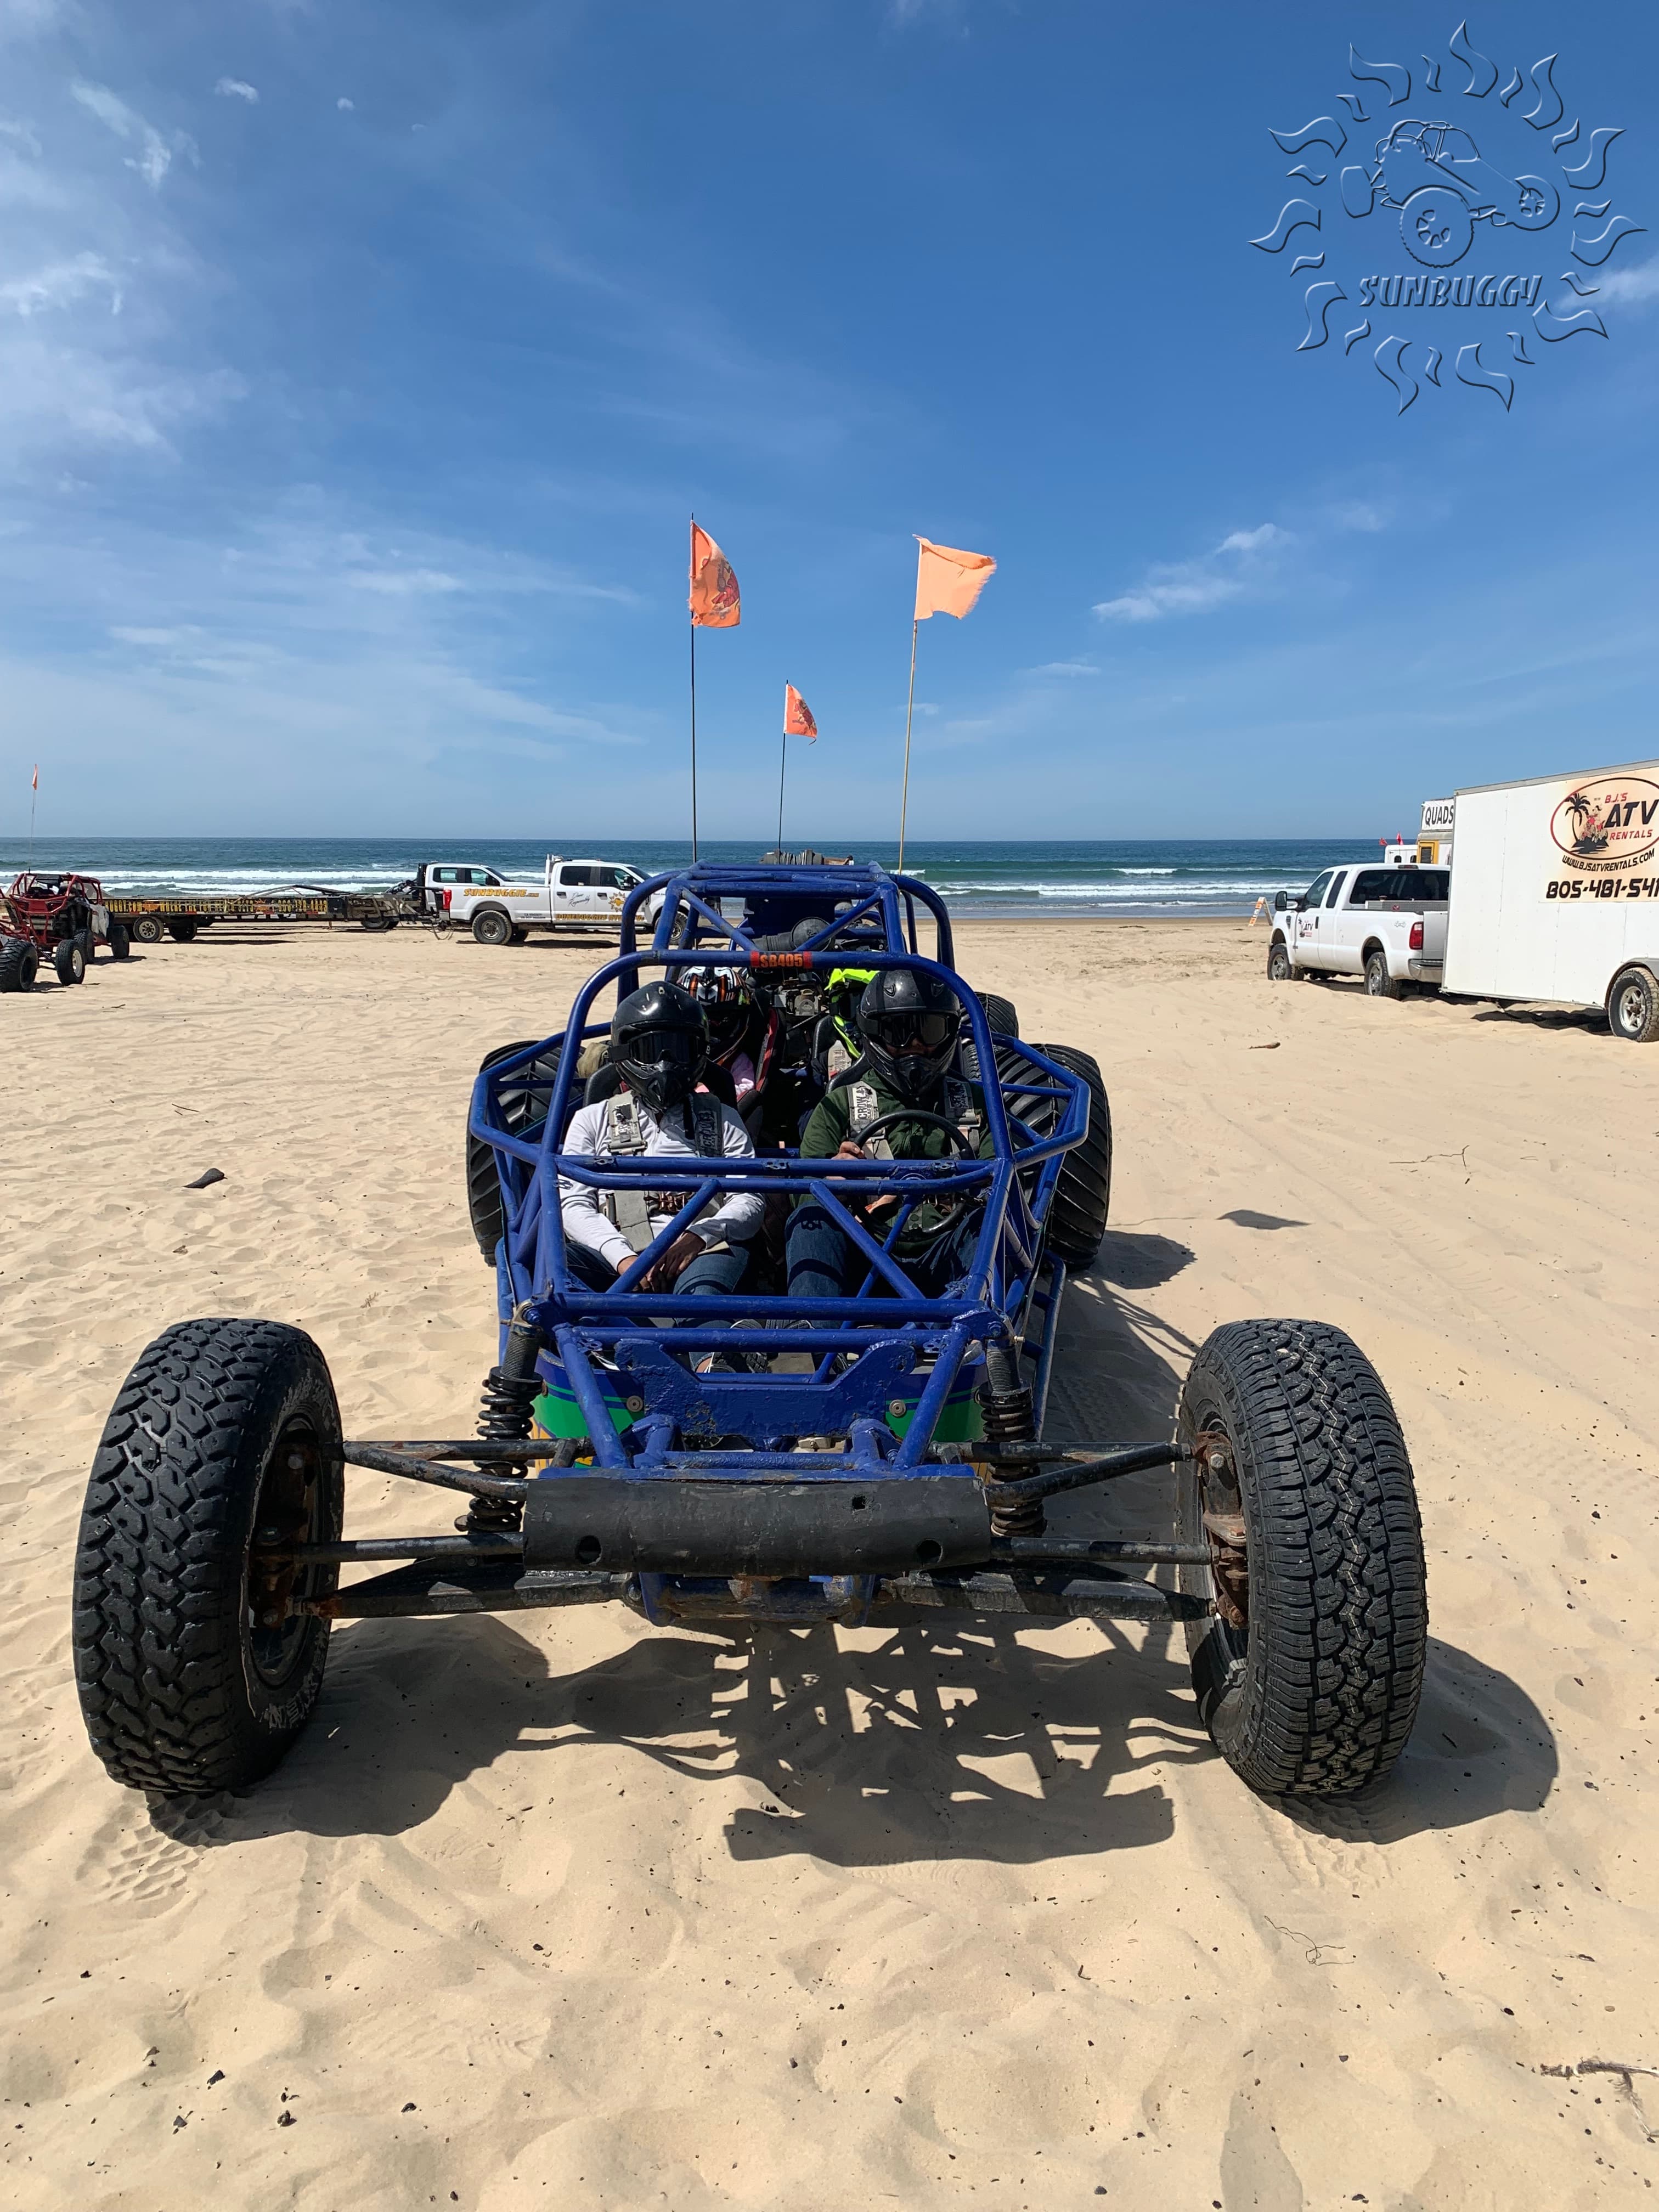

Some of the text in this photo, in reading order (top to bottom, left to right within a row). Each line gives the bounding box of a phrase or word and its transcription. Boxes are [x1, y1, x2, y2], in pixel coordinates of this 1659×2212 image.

[1425, 805, 1454, 826] QUADS
[1604, 799, 1659, 829] ATV
[1609, 829, 1653, 840] RENTALS
[1562, 848, 1655, 872] WWW.BJSATVRENTALS.COM
[760, 953, 803, 968] SB405
[856, 1096, 867, 1119] CROW
